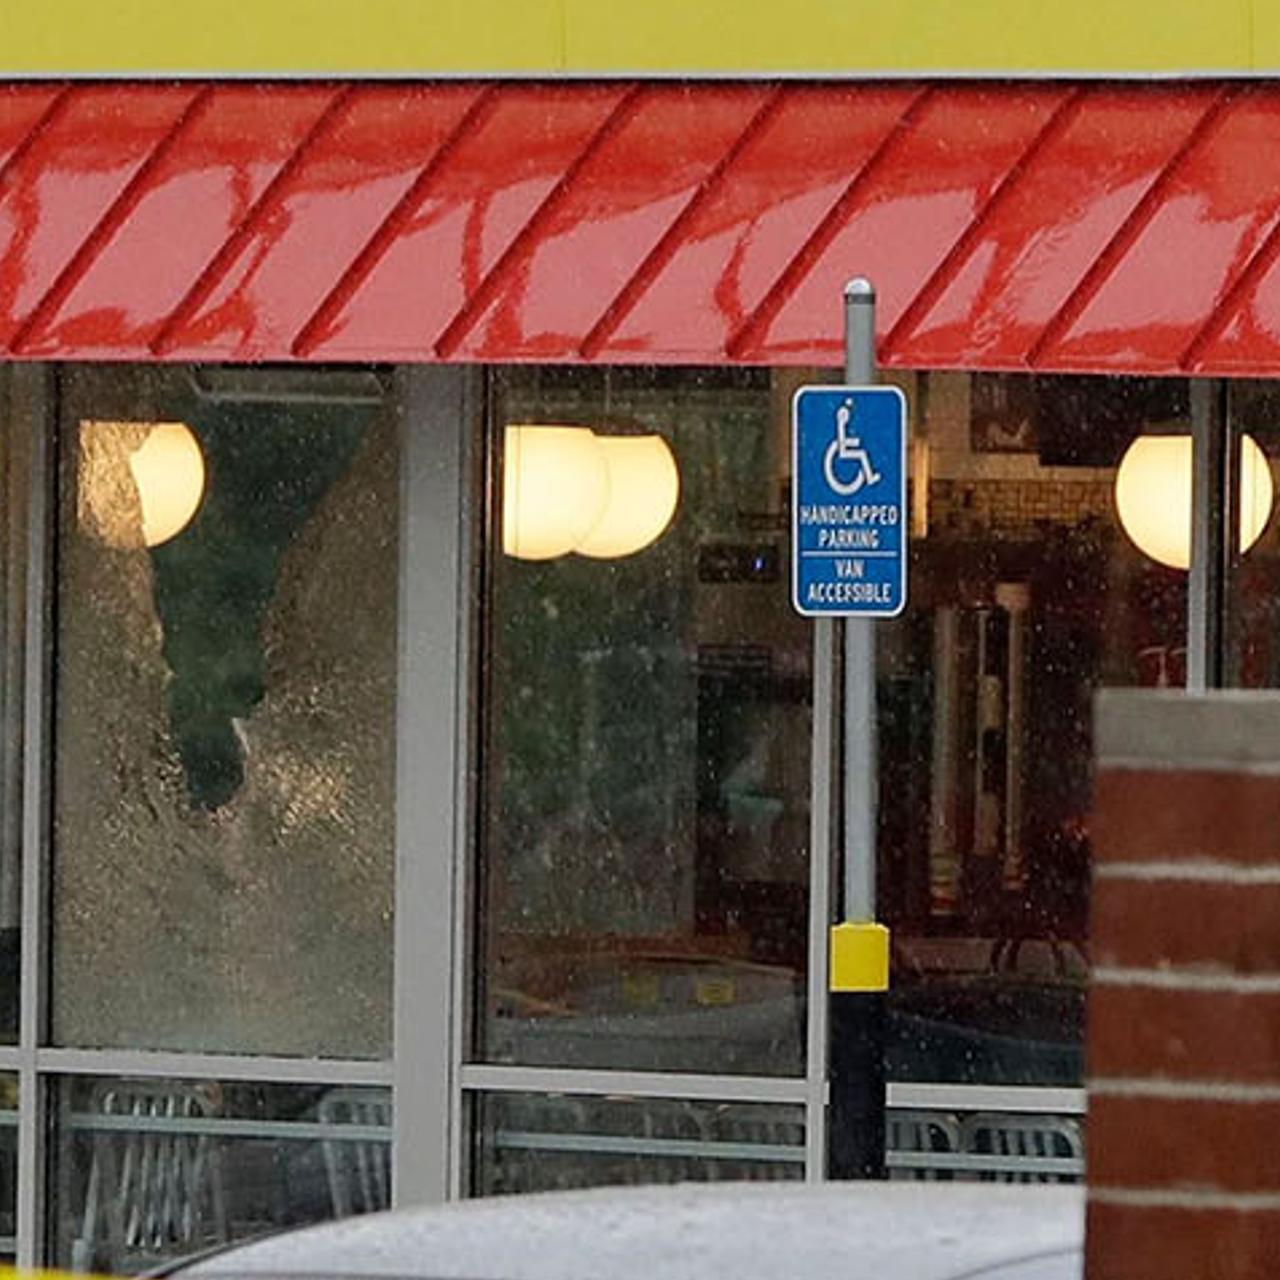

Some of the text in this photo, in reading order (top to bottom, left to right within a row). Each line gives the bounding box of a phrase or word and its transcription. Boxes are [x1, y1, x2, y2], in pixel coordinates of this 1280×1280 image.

[800, 505, 899, 525] HANDICAPPED
[819, 528, 879, 548] PARKING
[834, 558, 865, 578] VAN
[808, 582, 892, 603] ACCESSIBLE
